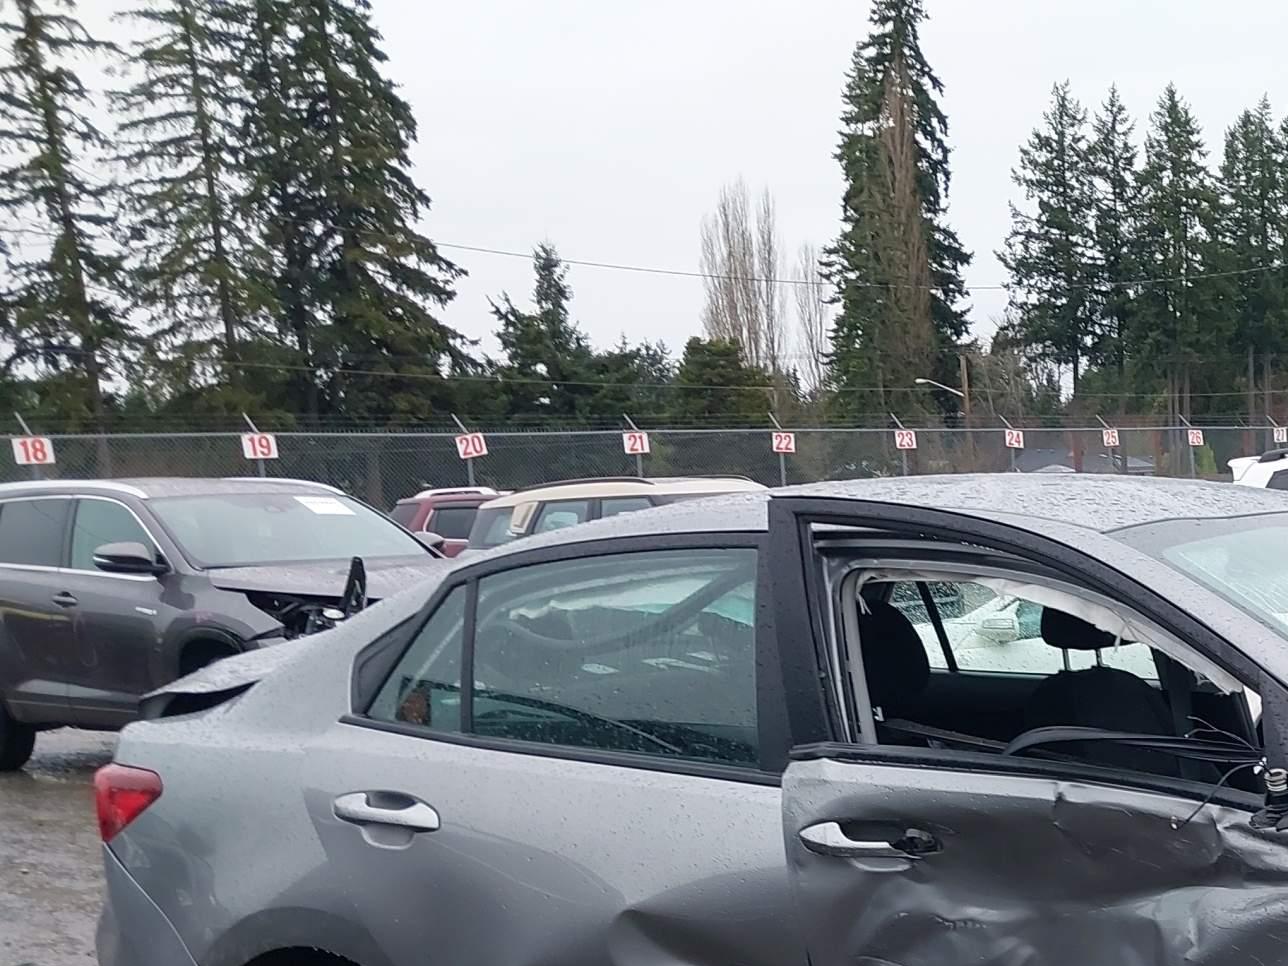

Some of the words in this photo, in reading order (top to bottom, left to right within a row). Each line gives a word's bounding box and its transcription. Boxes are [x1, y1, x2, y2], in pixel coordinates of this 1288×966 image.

[627, 433, 645, 452] 21
[774, 433, 793, 451] 22
[897, 431, 914, 448] 23
[1007, 432, 1022, 447] 24
[1104, 430, 1118, 445] 25
[1189, 430, 1202, 445] 26
[1275, 427, 1286, 442] 27
[19, 439, 48, 463] 18
[248, 435, 272, 457] 19
[459, 434, 484, 457] 20
